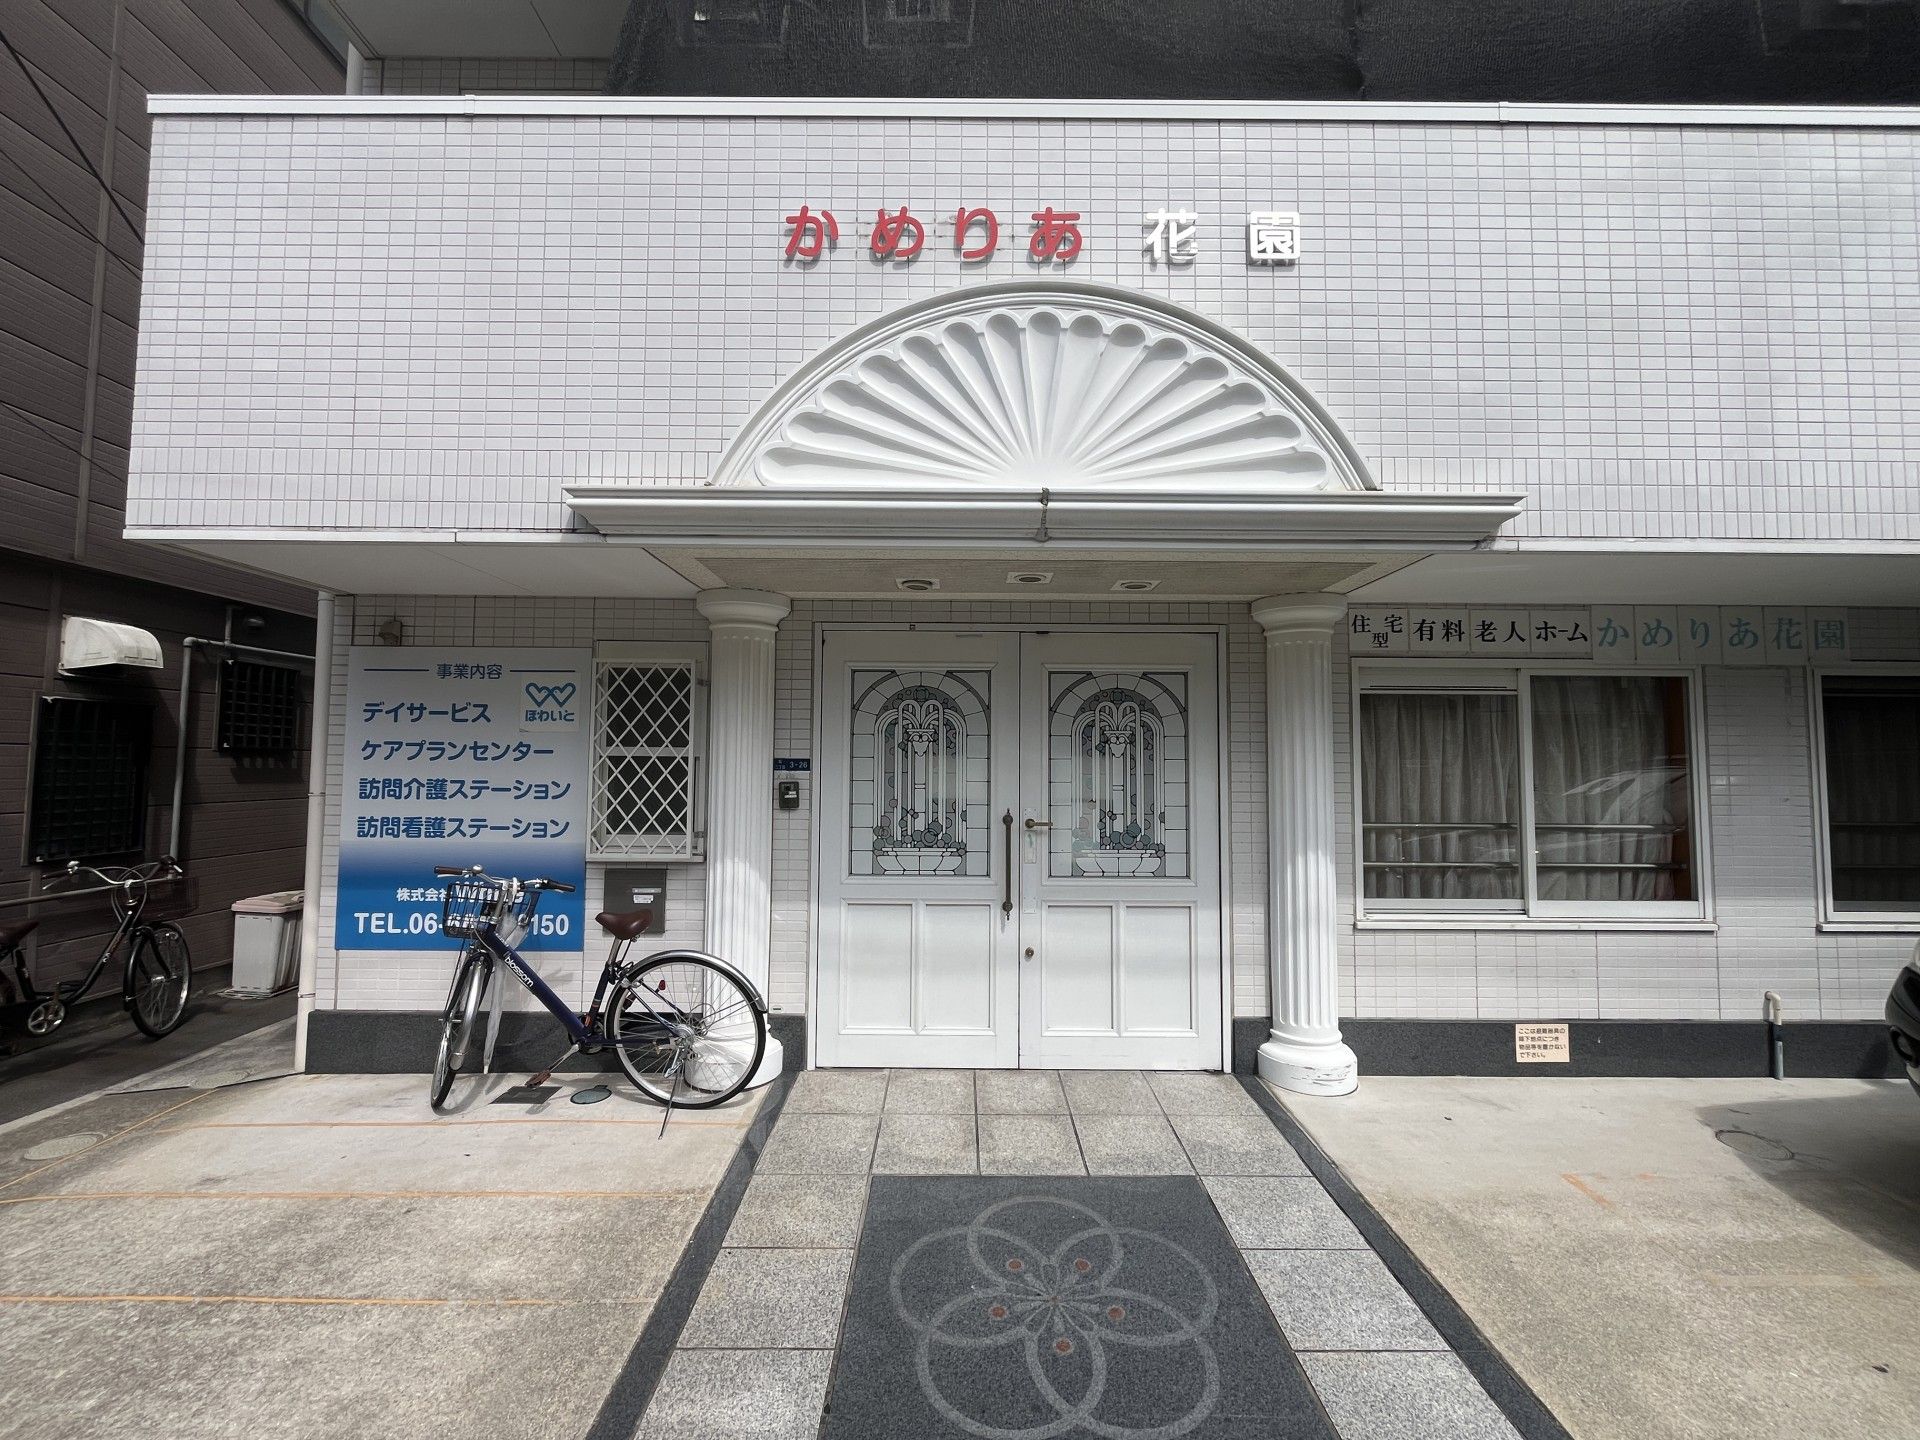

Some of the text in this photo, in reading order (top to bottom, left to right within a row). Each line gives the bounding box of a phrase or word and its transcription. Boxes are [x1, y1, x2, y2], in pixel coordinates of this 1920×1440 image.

[785, 205, 1301, 260] かめりあ 花園
[1596, 616, 1846, 650] かめりあ花園
[436, 663, 503, 680] 事業内容
[362, 701, 492, 723] デイサービス
[524, 709, 576, 722] ほわいと
[361, 739, 554, 762] ケアプランセンター
[358, 778, 571, 801] 訪問介護ステーション
[356, 816, 570, 839] 訪問看護ステーション
[504, 956, 534, 988] blossom
